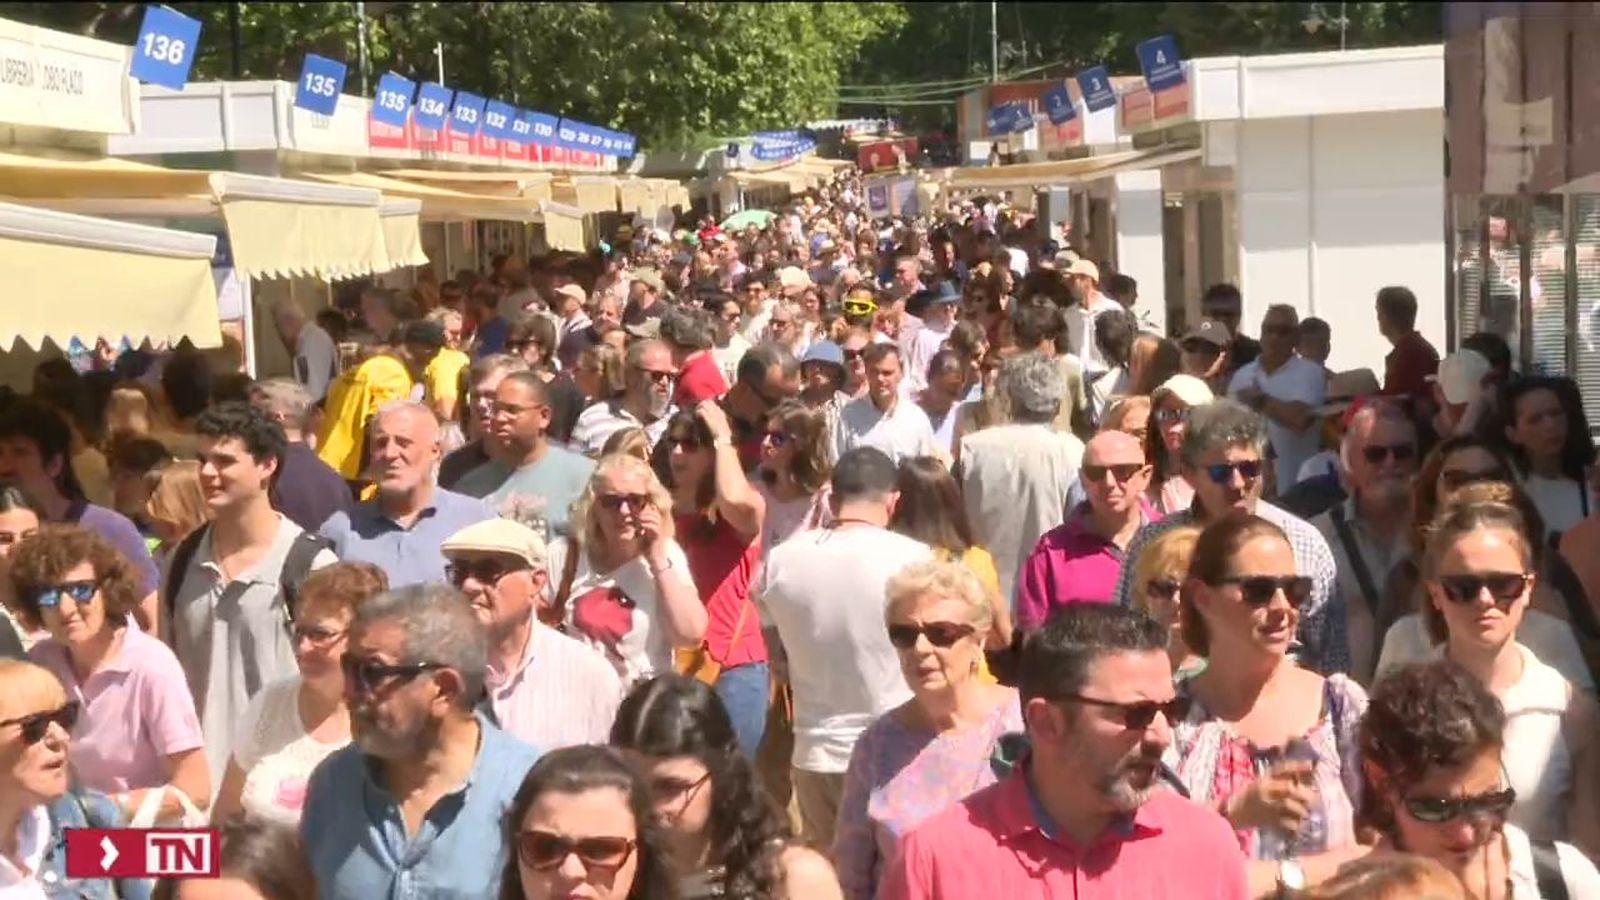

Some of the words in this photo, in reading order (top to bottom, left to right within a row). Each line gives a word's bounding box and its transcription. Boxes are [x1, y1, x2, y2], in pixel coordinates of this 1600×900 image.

[143, 32, 186, 65] 136
[1155, 49, 1166, 64] 4
[305, 72, 337, 97] 135
[379, 90, 406, 112] 135
[419, 97, 445, 117] 134
[455, 105, 477, 124] 133
[486, 111, 507, 129] 132
[512, 119, 530, 134] 131
[534, 122, 553, 137] 130
